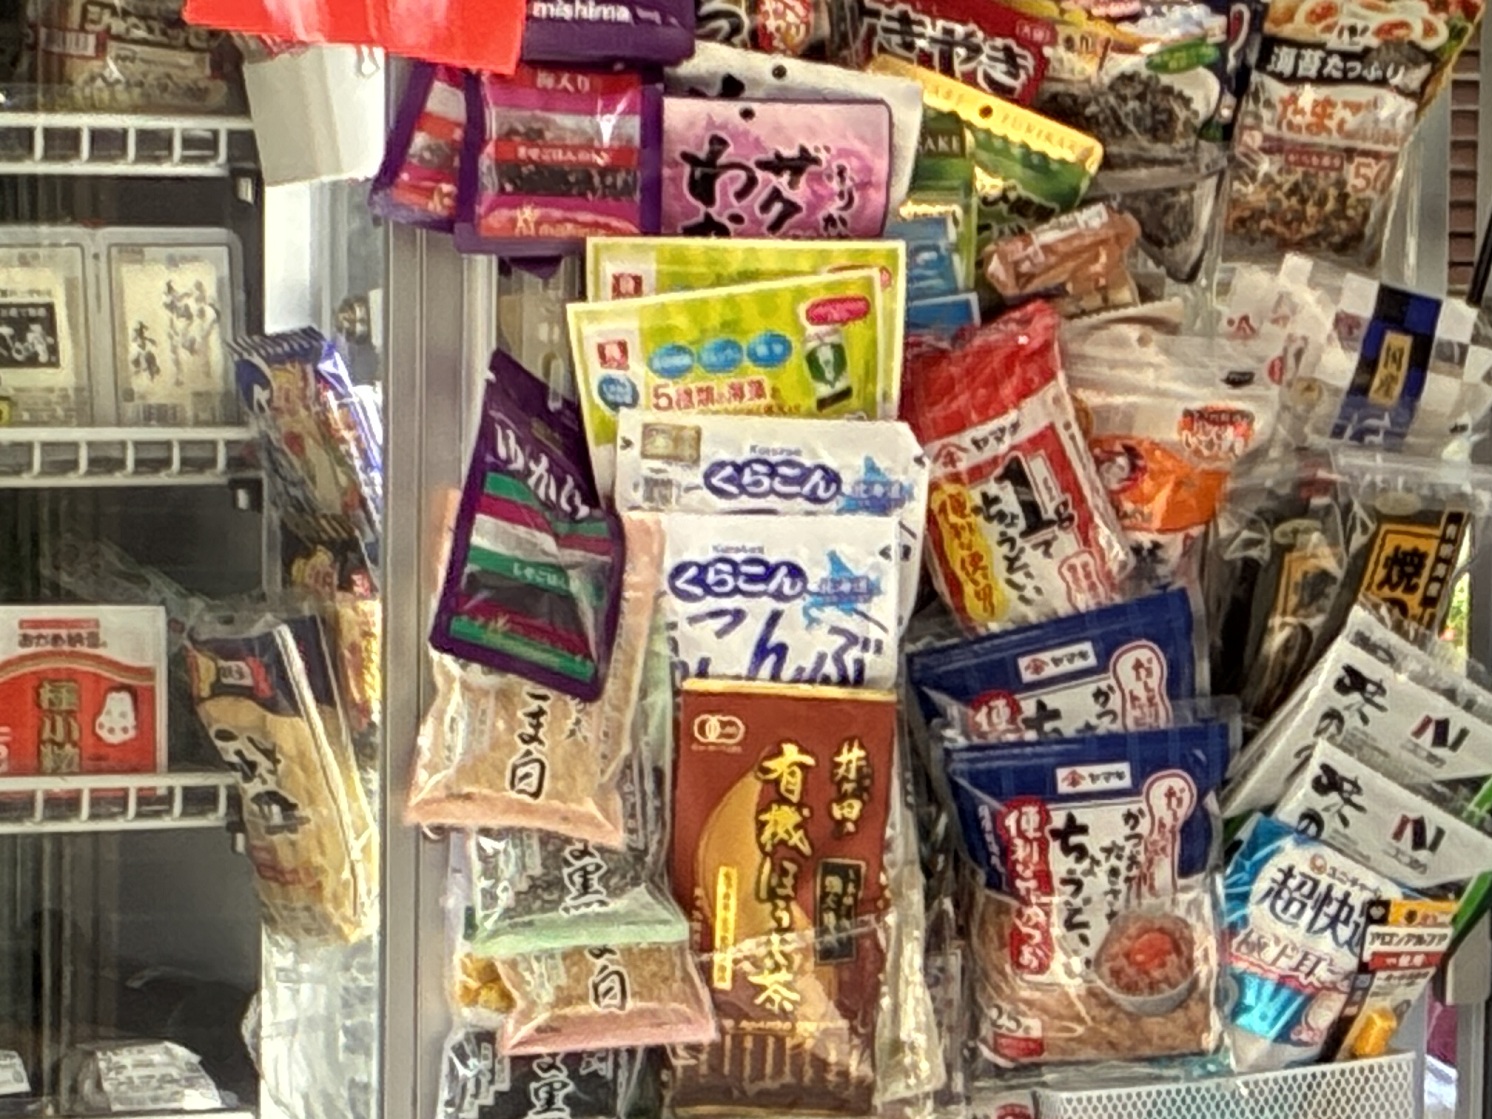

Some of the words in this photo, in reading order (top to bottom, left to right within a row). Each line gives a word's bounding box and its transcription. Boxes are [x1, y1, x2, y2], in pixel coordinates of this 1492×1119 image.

[710, 463, 838, 500] くらこん
[675, 559, 802, 597] くらこん
